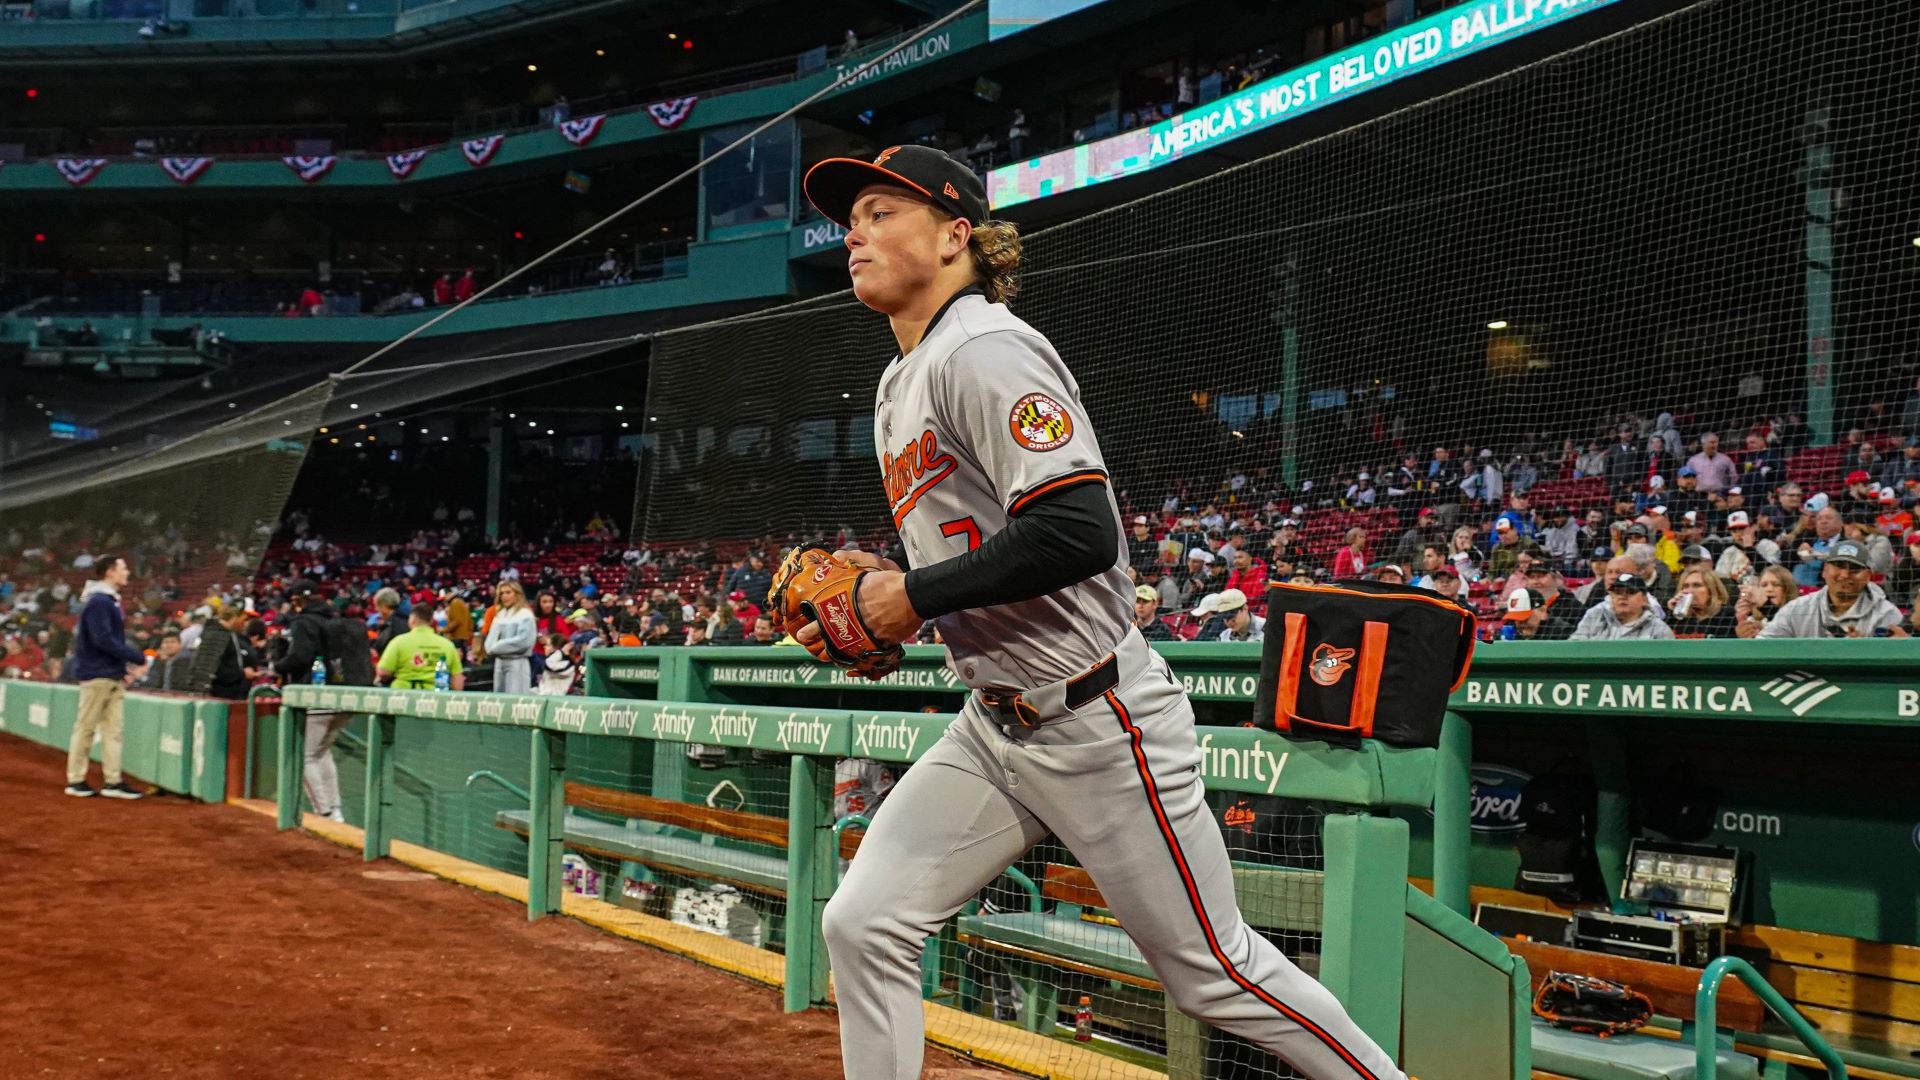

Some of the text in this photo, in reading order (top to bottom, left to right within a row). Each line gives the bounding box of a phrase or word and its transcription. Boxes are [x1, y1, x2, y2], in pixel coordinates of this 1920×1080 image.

[884, 32, 950, 72] PAVILION
[1150, 98, 1254, 160] AMERICA'S
[1259, 71, 1321, 119] MOST
[1329, 27, 1442, 95] BELOVED
[804, 223, 843, 248] DELL
[1011, 395, 1063, 421] BALTIMORE
[1028, 433, 1069, 449] ORIOLES
[939, 516, 982, 551] 7
[826, 602, 853, 641] Rawlings
[713, 668, 796, 683] BANK OF AMERICA
[880, 670, 935, 686] AMERICA
[1183, 675, 1236, 696] BANK
[511, 697, 542, 725] xfinity
[1467, 681, 1752, 712] BANK OF AMERICA
[553, 701, 589, 733] xfinity
[600, 703, 639, 735] xfinity
[653, 705, 695, 742] xfinity
[709, 708, 758, 744] xfinity
[776, 712, 832, 753] xfinity
[855, 715, 920, 759] xfinity
[1200, 733, 1289, 794] finity
[1471, 788, 1523, 822] ord
[1712, 811, 1781, 836] .com
